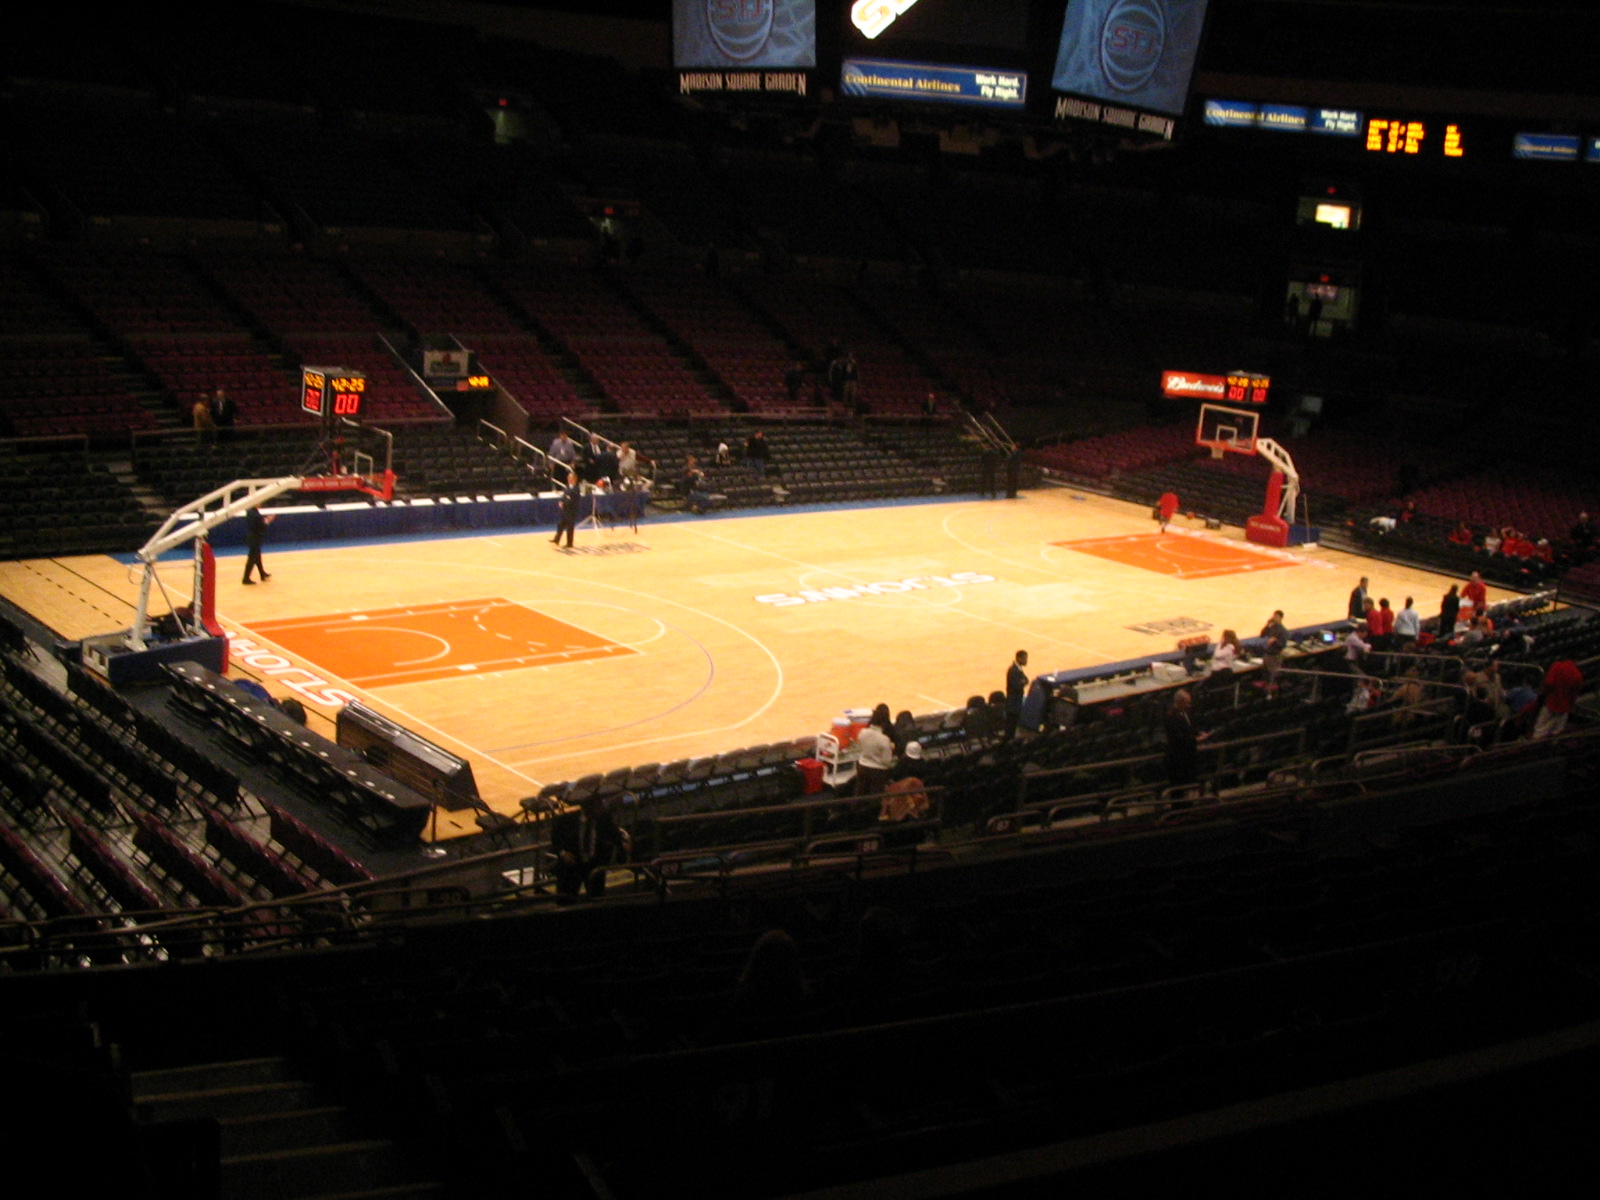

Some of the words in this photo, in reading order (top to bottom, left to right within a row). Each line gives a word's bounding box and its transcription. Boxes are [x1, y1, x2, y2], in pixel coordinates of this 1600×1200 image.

[679, 72, 723, 95] MADISON
[725, 73, 762, 91] SQUARE
[764, 72, 807, 96] GARDEN
[843, 73, 913, 89] Continental
[914, 78, 962, 93] Airlines
[974, 73, 997, 86] Work
[980, 85, 994, 98] Fly
[1054, 96, 1101, 121] MADISON
[1102, 106, 1137, 129] SQUARE
[1138, 113, 1175, 141] GARDEN
[1206, 108, 1265, 122] Continental
[1266, 112, 1307, 126] Airlines
[331, 377, 366, 393] 42:25
[333, 393, 360, 415] 00
